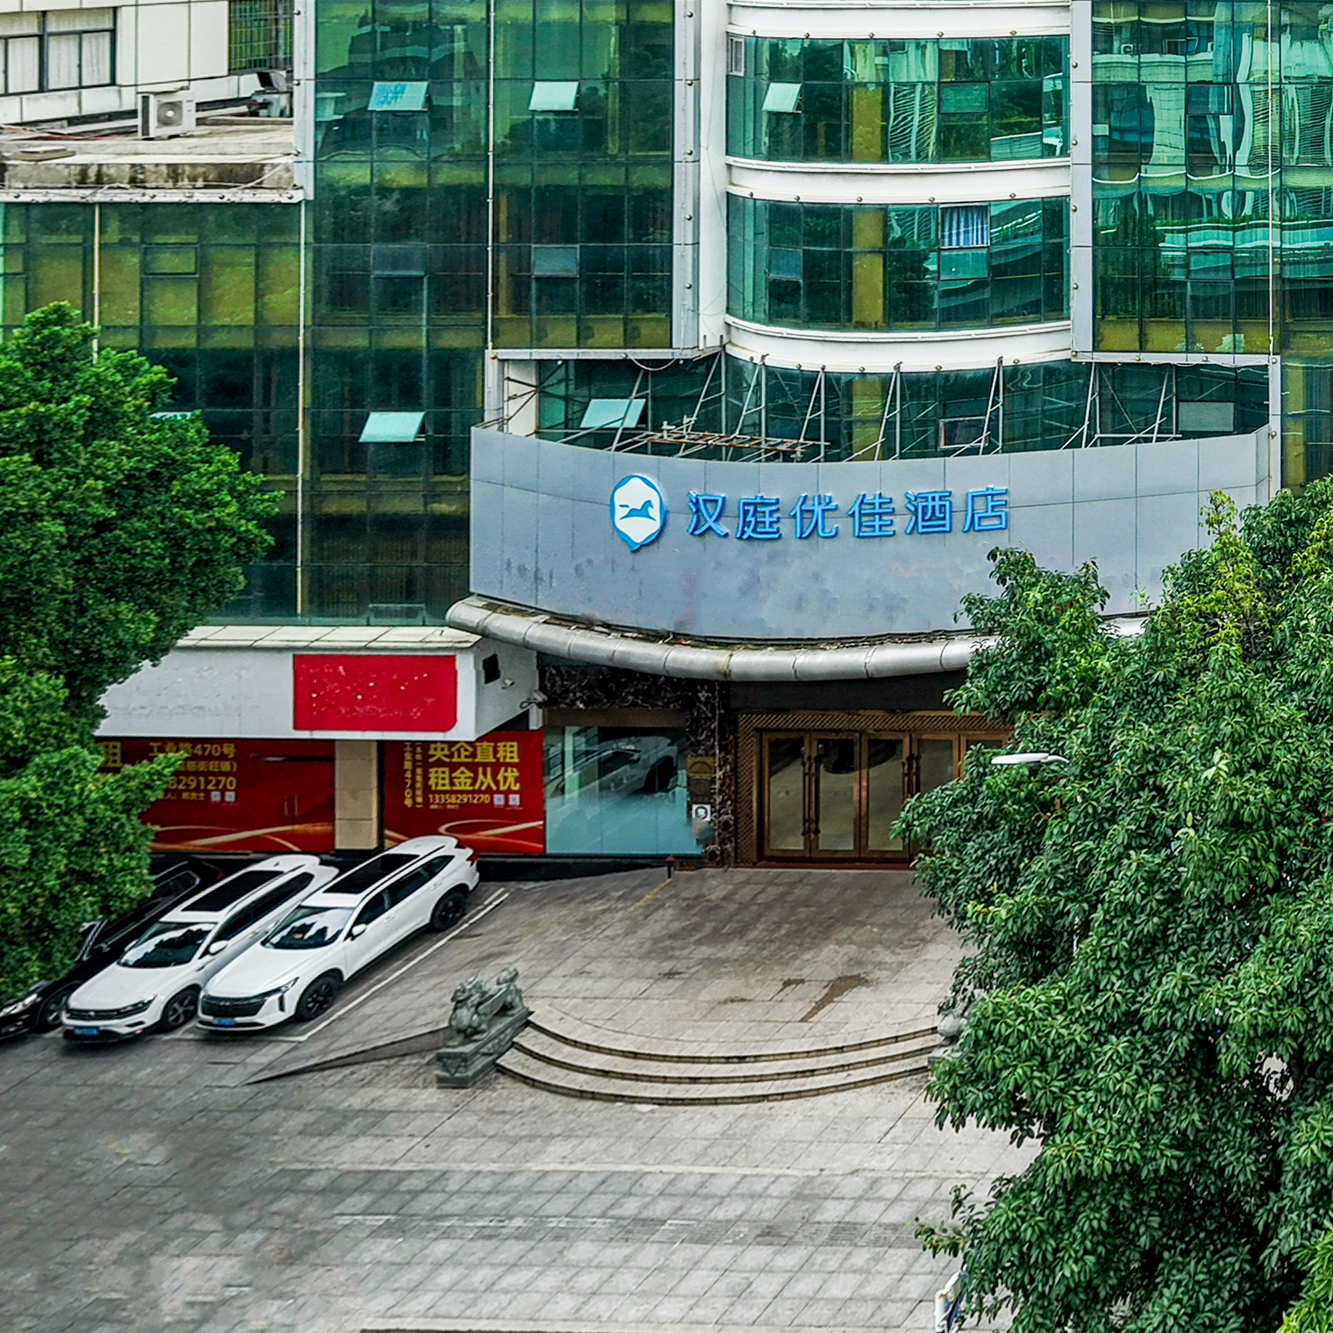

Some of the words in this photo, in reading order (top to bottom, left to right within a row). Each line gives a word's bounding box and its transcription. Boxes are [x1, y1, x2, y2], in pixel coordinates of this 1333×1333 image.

[686, 486, 1009, 541] 汉庭优佳酒店
[428, 741, 520, 763] 央企直租
[428, 766, 520, 791] 租金从优
[428, 793, 491, 804] 13358291270
